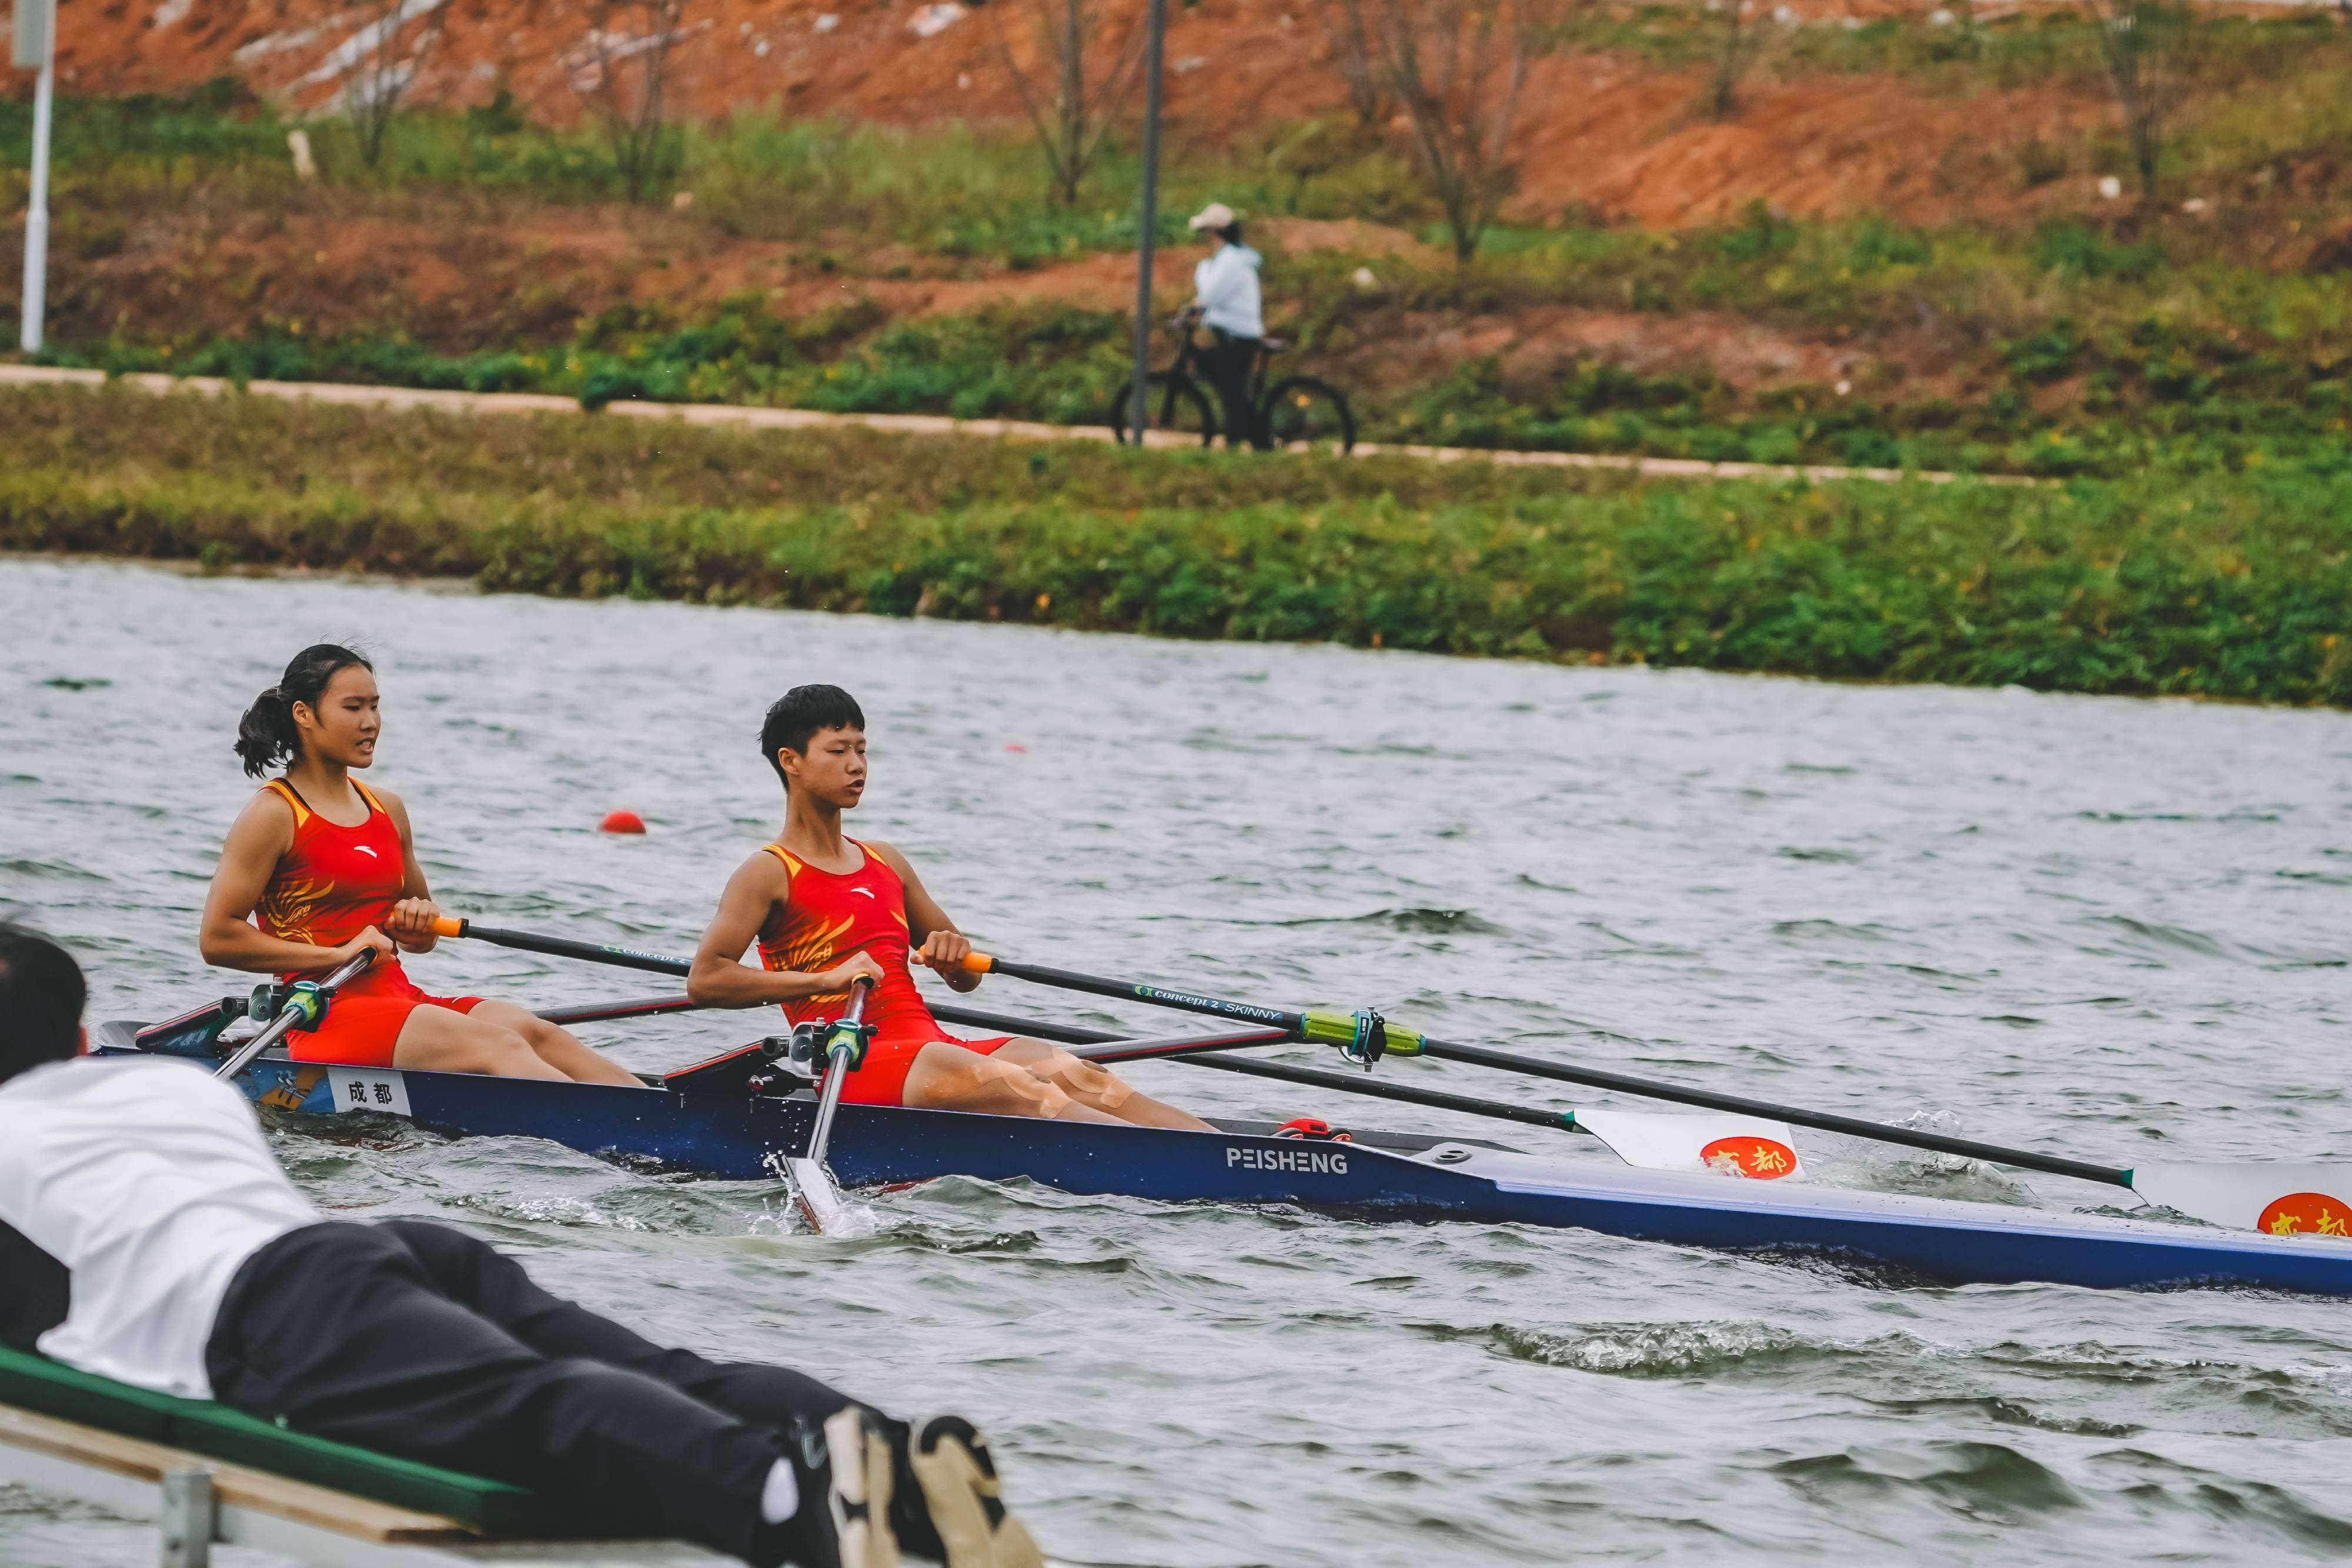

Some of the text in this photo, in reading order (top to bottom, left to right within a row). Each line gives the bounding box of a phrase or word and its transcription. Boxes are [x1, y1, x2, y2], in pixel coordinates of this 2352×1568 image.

[623, 948, 676, 962] concept
[1154, 990, 1281, 1020] concept 2 SKINNY
[348, 1081, 393, 1105] 成都
[1226, 1148, 1348, 1175] PEISHENG
